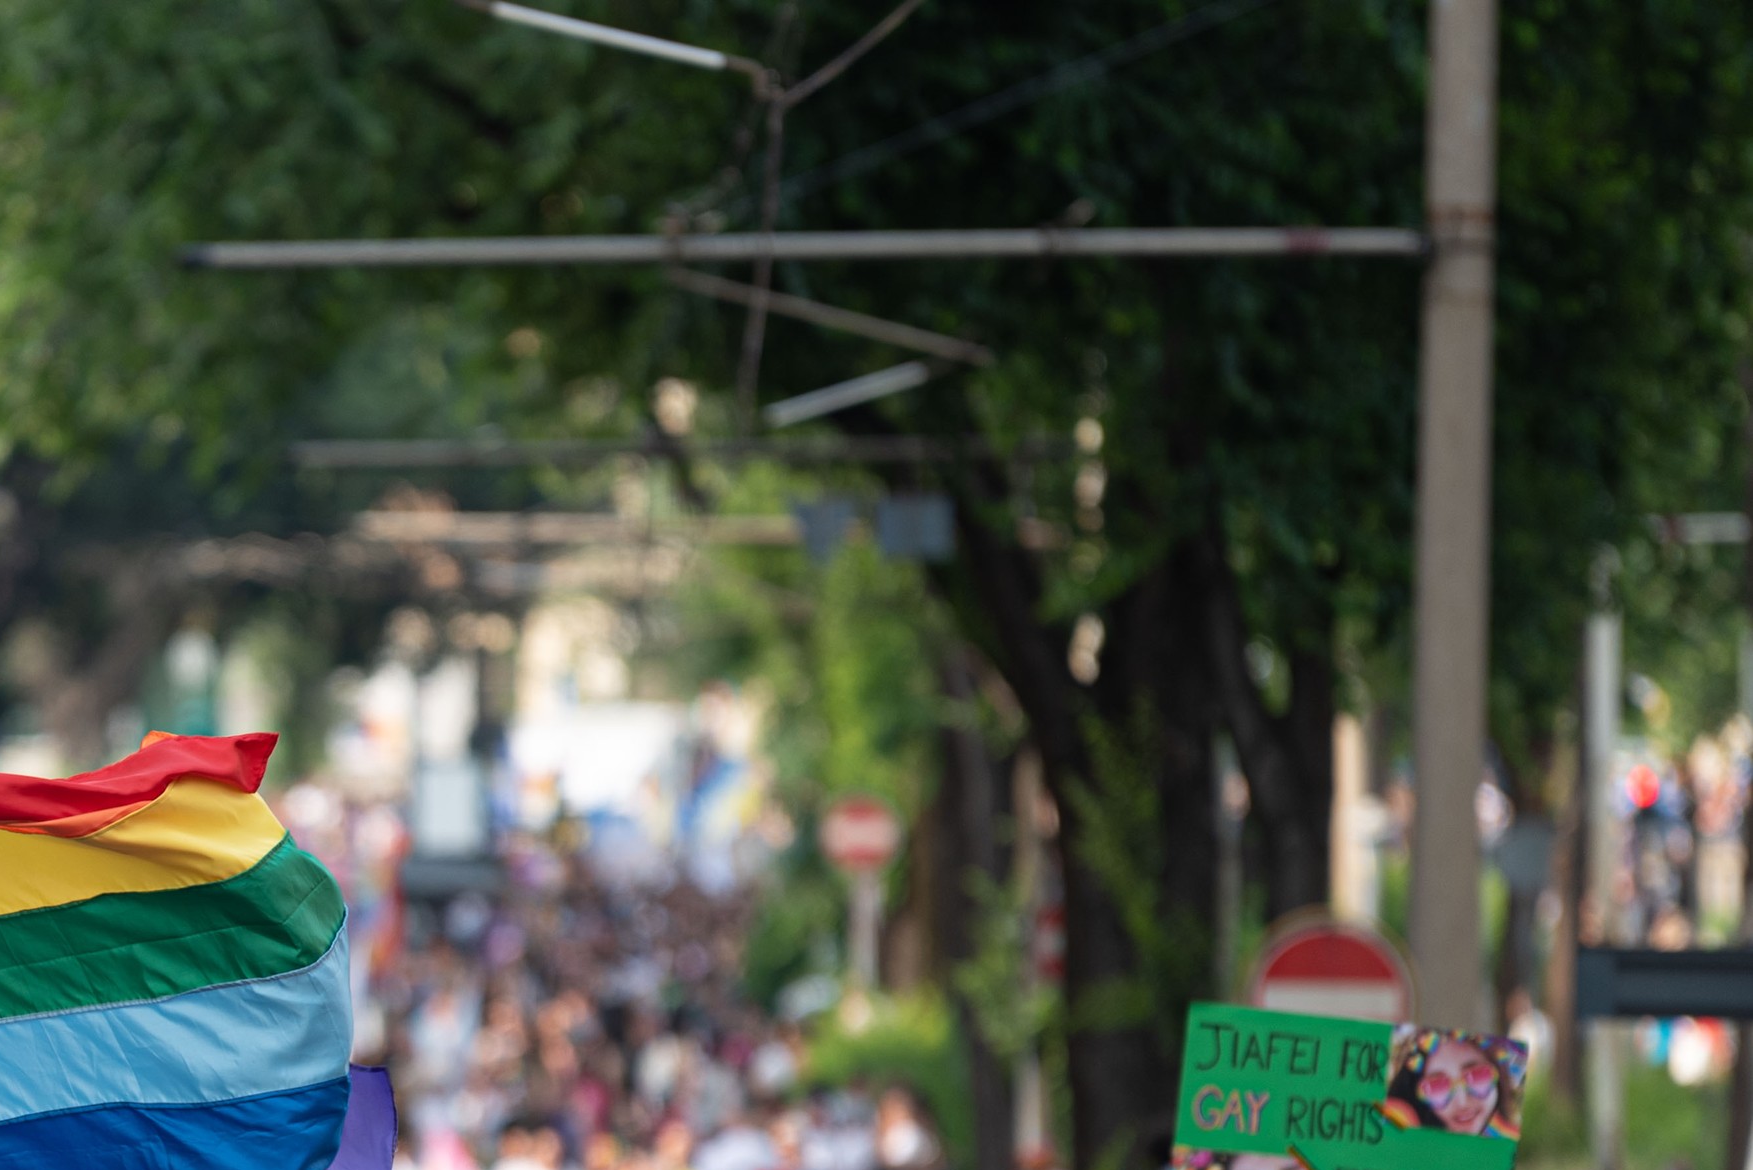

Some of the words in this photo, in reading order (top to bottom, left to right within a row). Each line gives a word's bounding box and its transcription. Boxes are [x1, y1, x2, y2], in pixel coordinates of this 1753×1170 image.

[1196, 1021, 1321, 1075] JIAFEI
[1339, 1038, 1390, 1084] FOR
[1192, 1084, 1271, 1136] GAY
[1285, 1095, 1385, 1145] RIGHTS
